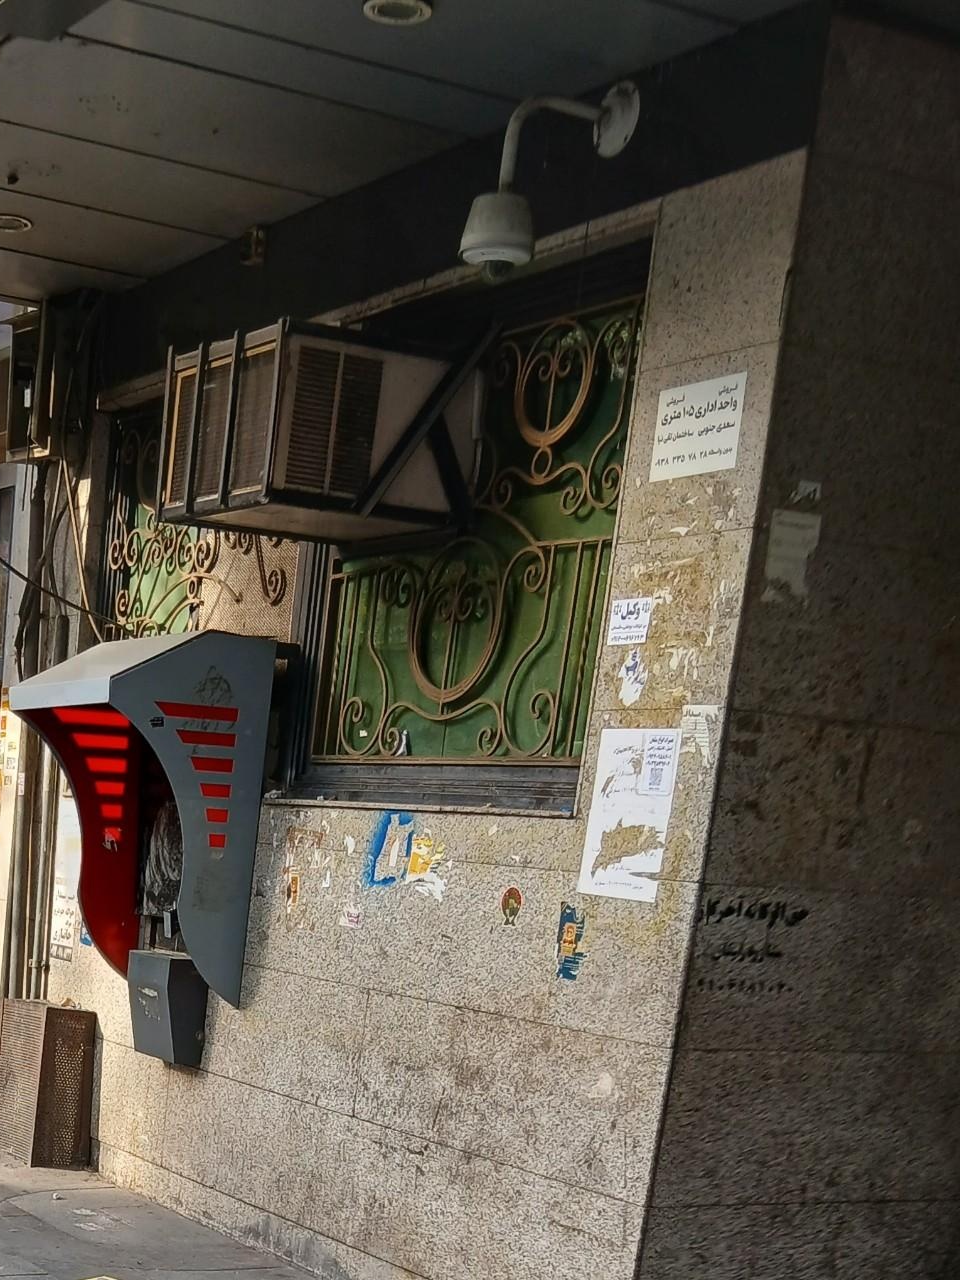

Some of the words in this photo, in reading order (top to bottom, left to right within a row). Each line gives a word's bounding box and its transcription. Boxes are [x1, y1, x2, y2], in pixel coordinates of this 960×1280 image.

[695, 399, 718, 419] اداری
[717, 396, 738, 411] واحد
[661, 410, 681, 426] متری
[621, 602, 640, 620] وکیل
